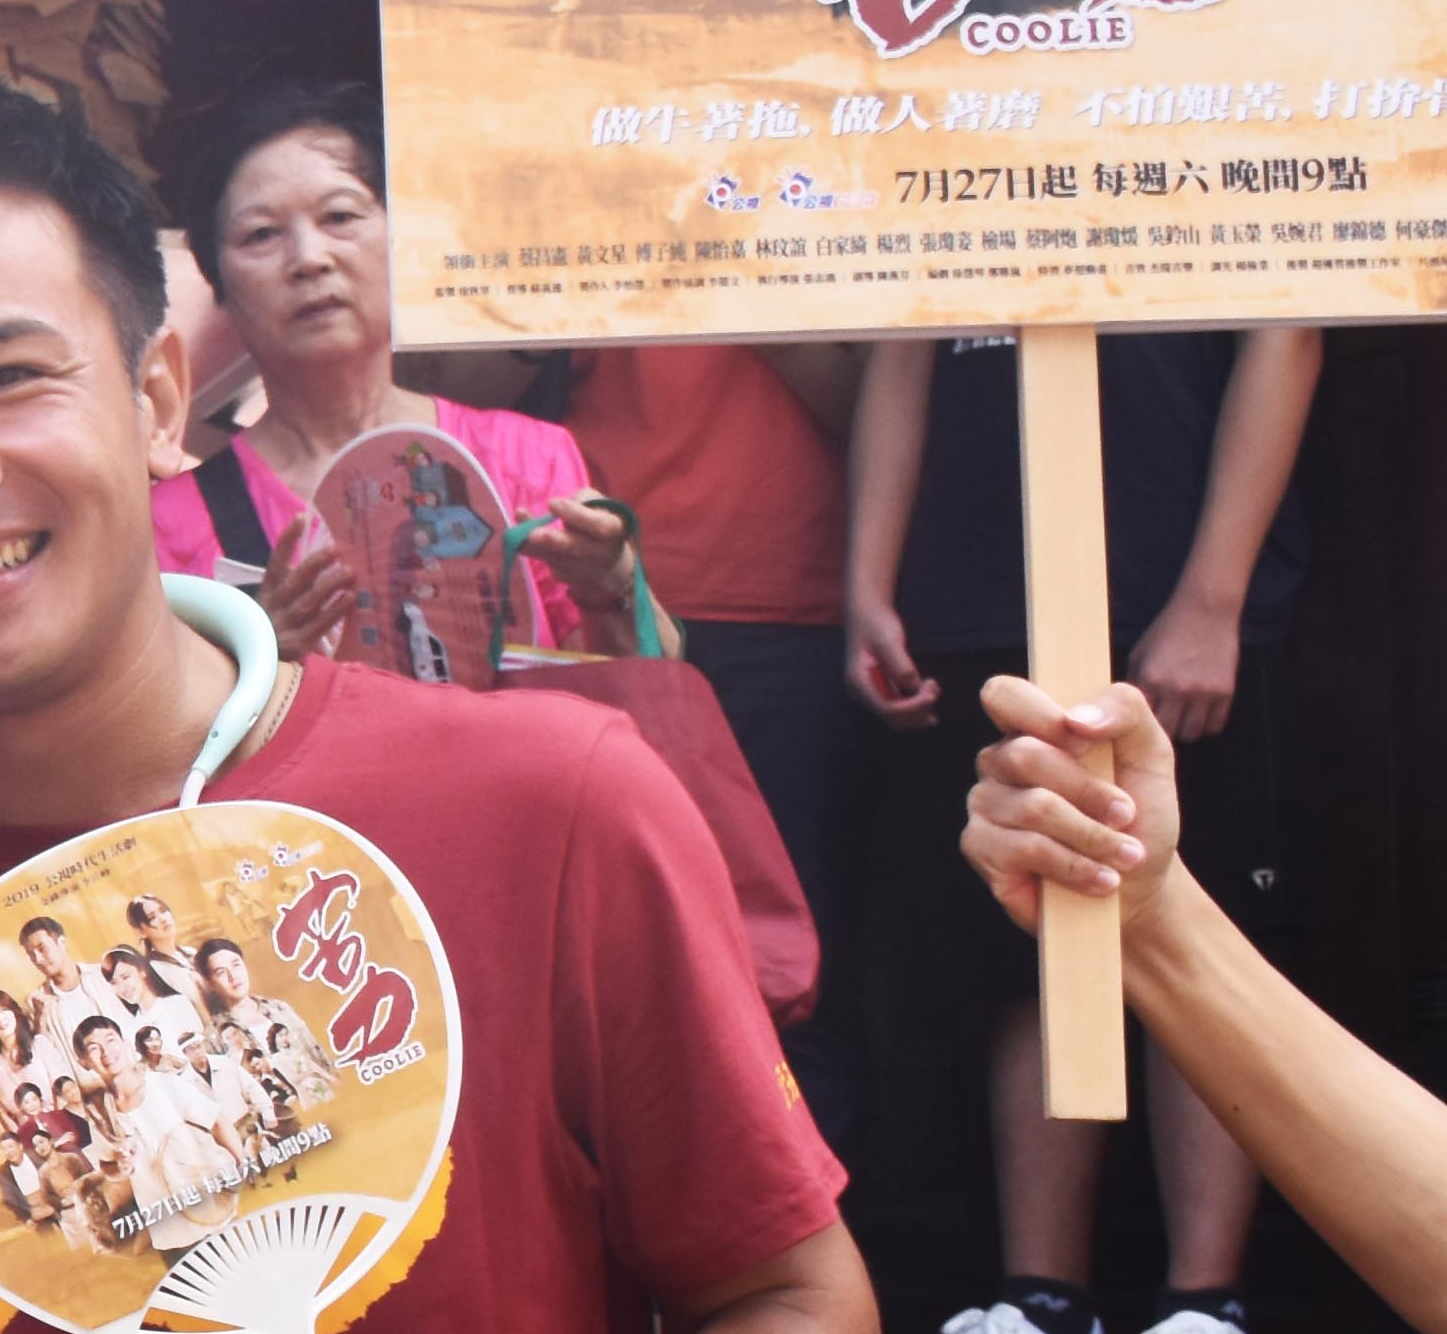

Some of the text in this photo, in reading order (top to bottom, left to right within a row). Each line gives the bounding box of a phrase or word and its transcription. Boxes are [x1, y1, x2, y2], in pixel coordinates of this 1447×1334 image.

[965, 16, 1129, 48] COOLIE
[894, 155, 1367, 204] 7月27日起 每週六 晚間9點
[3, 883, 39, 908] 2019
[360, 1044, 424, 1082] COOLIE
[112, 1122, 332, 1239] 7月27日起 每週六 晚間9點
